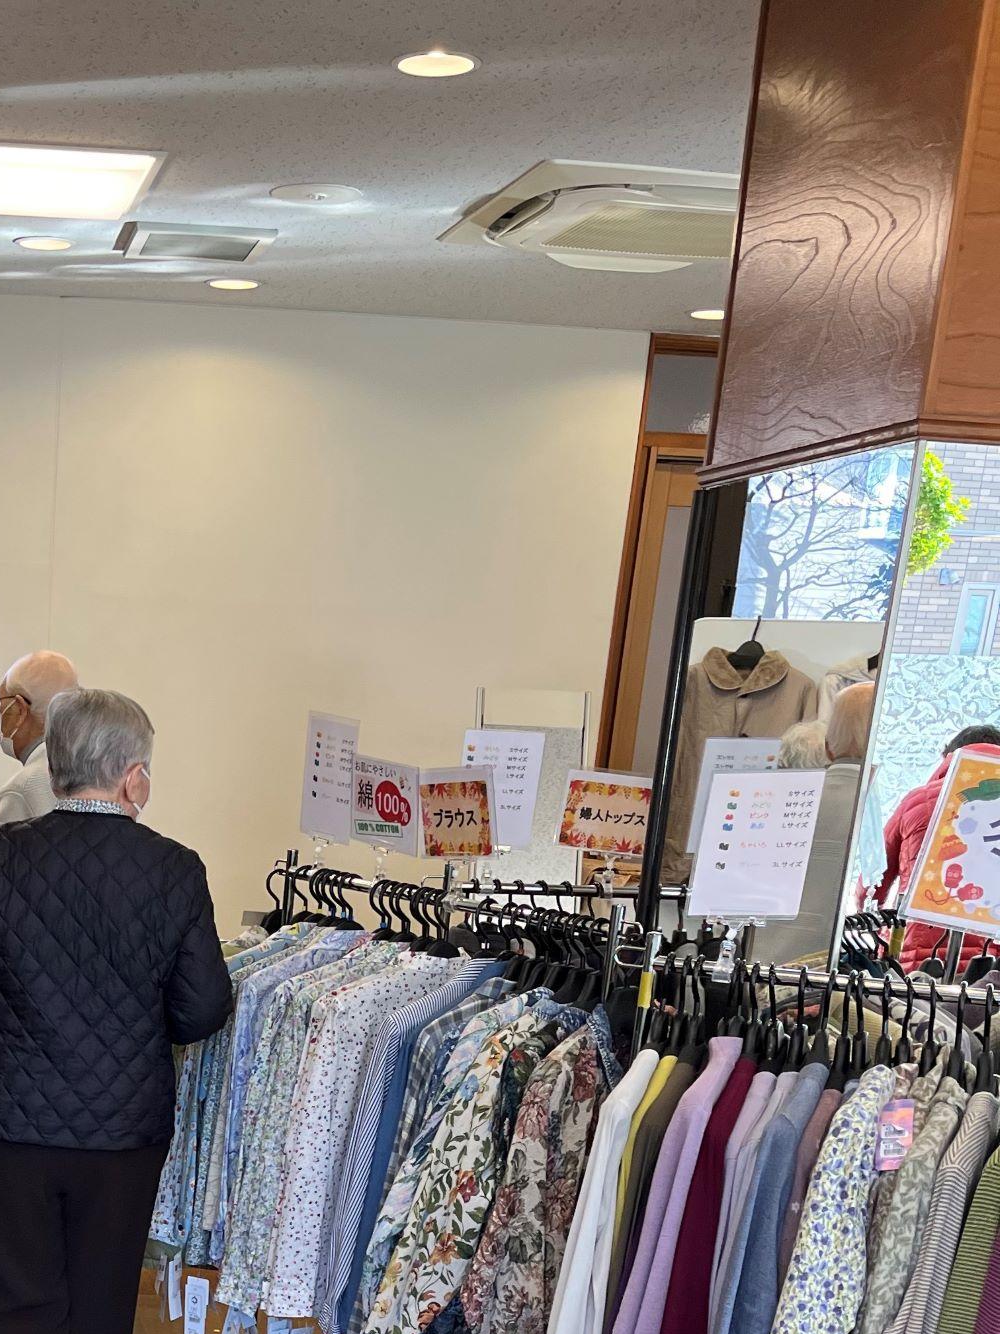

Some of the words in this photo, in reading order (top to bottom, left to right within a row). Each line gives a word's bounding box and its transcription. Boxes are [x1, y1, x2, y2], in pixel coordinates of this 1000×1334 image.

[355, 761, 397, 777] お肌にやさしい
[358, 779, 374, 810] 綿
[377, 791, 409, 823] 100%
[433, 808, 477, 828] ブラウス
[579, 806, 645, 826] 婦人トップス
[376, 824, 399, 833] COTTON
